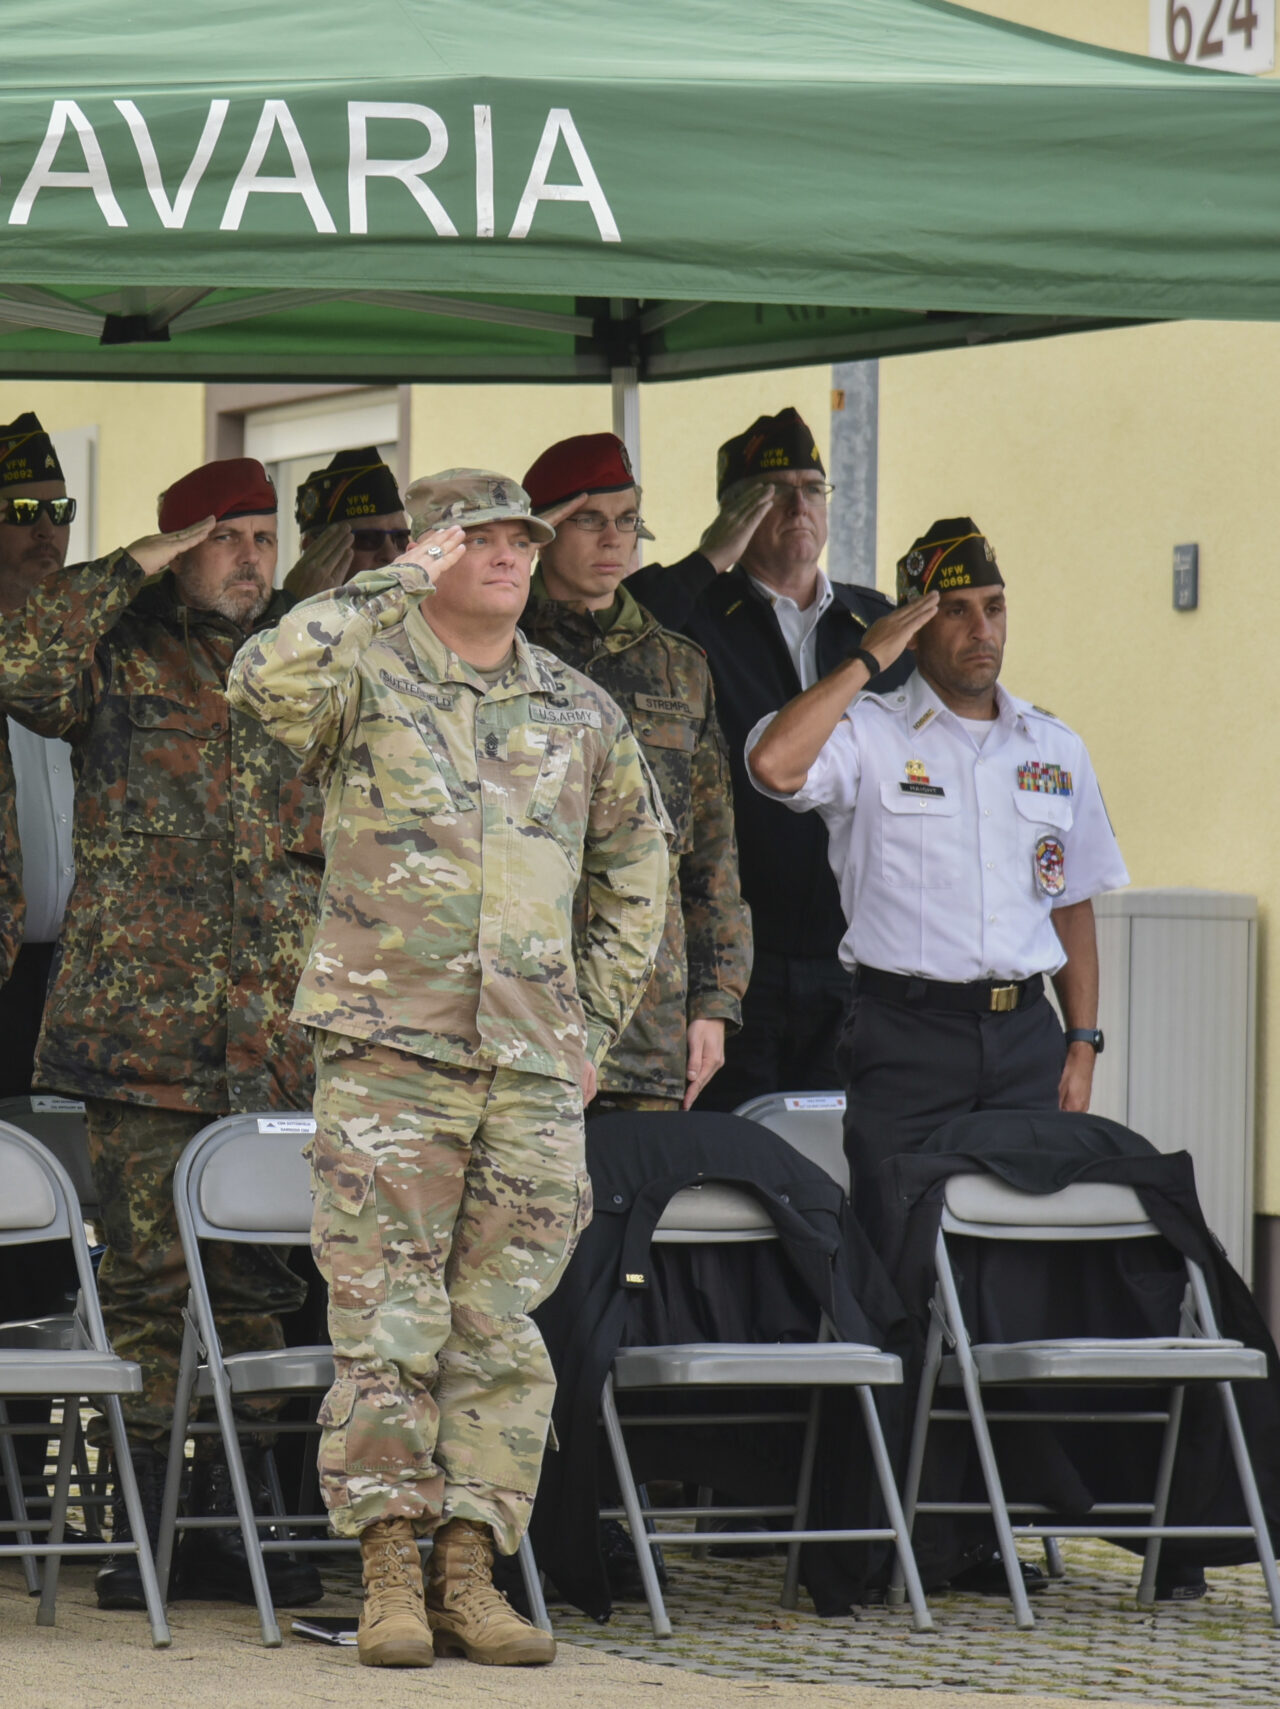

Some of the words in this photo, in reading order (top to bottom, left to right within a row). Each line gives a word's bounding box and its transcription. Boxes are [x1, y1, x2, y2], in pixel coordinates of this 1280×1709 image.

[1166, 0, 1258, 64] 624
[6, 457, 27, 470] VFW
[346, 494, 369, 505] VFW
[940, 564, 964, 577] VFW
[938, 573, 972, 588] 10692
[646, 698, 693, 714] STREMPEL
